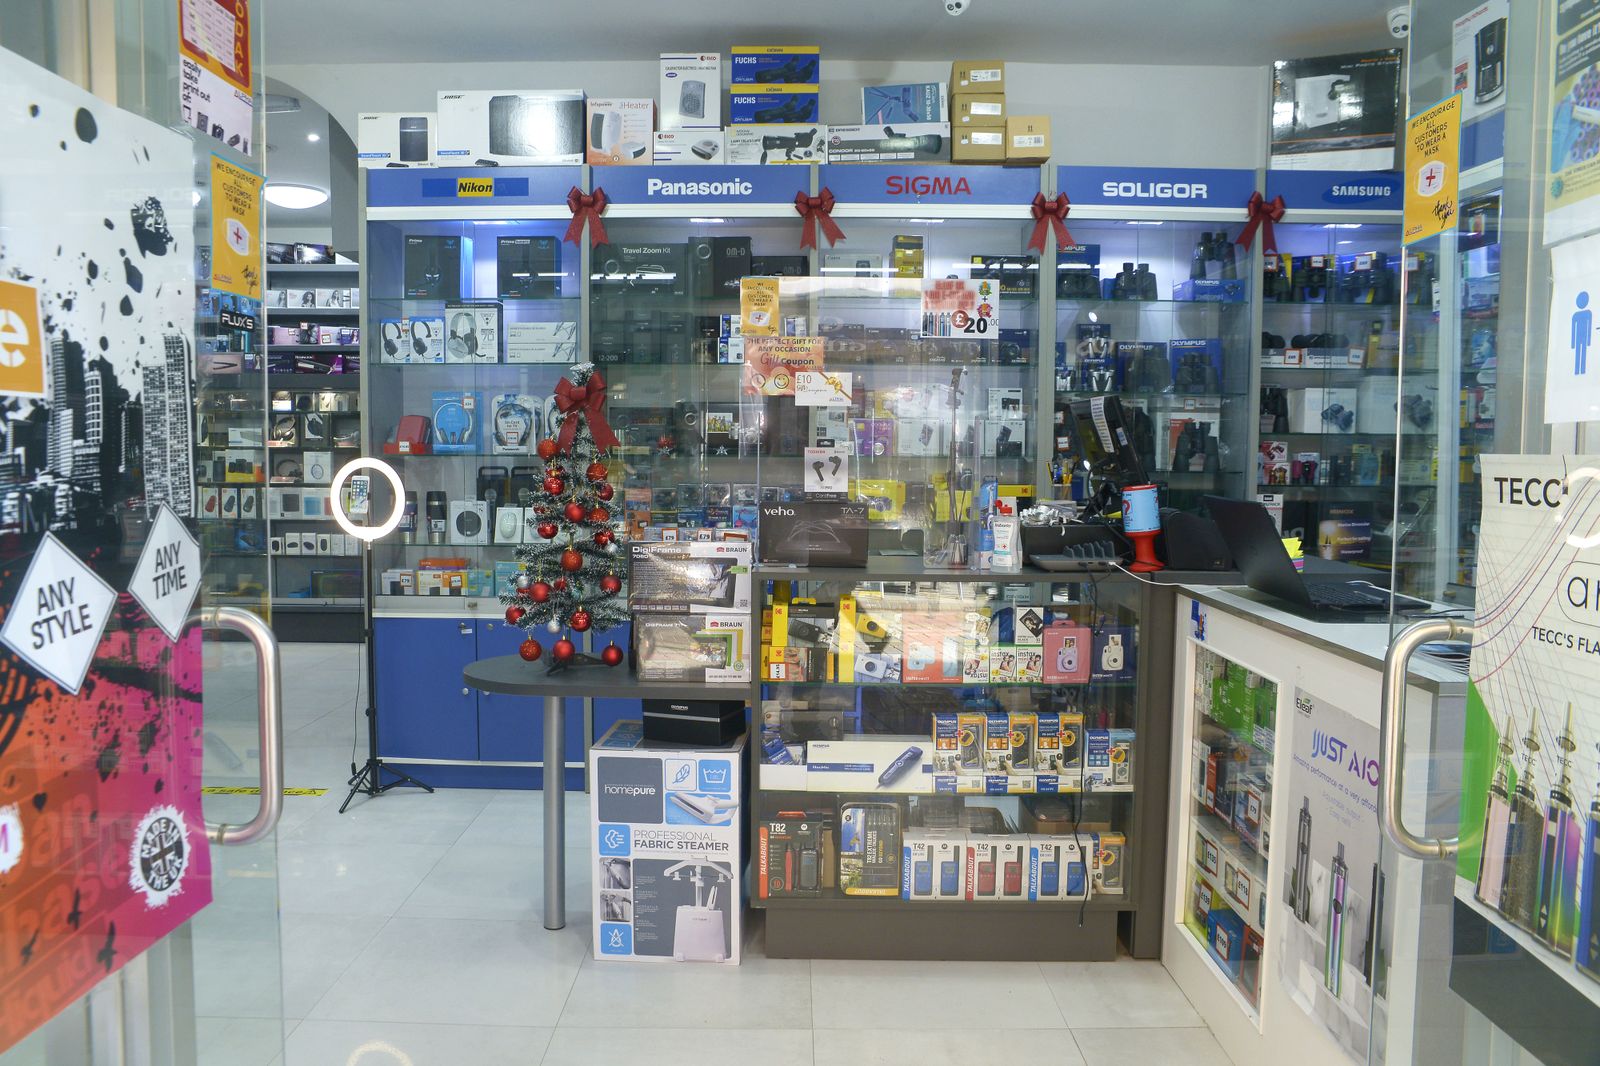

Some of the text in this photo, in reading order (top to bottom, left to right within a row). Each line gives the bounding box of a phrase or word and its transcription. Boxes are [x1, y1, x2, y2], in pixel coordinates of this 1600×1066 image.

[235, 0, 244, 77] ODAK
[1412, 101, 1456, 129] WE ENCOURAGE
[1414, 122, 1448, 145] CUSTOMERS
[1425, 120, 1435, 130] ALL
[1416, 143, 1424, 152] TO
[1425, 136, 1442, 149] WEAR
[1424, 146, 1440, 157] MASK
[216, 162, 225, 172] WE
[222, 182, 252, 202] CUSTOMERS
[458, 182, 493, 193] Nikon
[648, 178, 752, 197] Panasonic
[886, 175, 971, 195] SIGMA
[1102, 182, 1208, 199] SOLIGOR
[1332, 185, 1391, 197] SAMSUNG
[781, 357, 814, 366] Coupon
[797, 375, 812, 384] £10
[1494, 476, 1561, 508] TECC
[764, 506, 795, 516] veho
[155, 541, 181, 573] ANY
[632, 546, 682, 554] DigiFrame
[152, 566, 187, 600] TIME
[37, 577, 75, 615] ANY
[31, 604, 93, 650] STYLE
[1531, 625, 1574, 650] TECC'S
[1296, 697, 1313, 715] Eleaf
[1521, 753, 1537, 766] TECC
[1556, 755, 1572, 769] TECC
[1348, 750, 1380, 787] AIO
[604, 784, 656, 796] homepure
[634, 829, 716, 842] PROFESSIONAL
[769, 823, 786, 833] T82
[141, 819, 167, 858] MADE
[634, 839, 729, 852] FABRIC STEAMER
[912, 843, 925, 851] T42
[976, 843, 989, 851] T42
[1040, 843, 1053, 851] T42
[760, 837, 768, 876] TALKABOUT
[148, 871, 168, 889] THE
[903, 855, 911, 892] TALKABOUT
[967, 856, 975, 893] TALKABOUT
